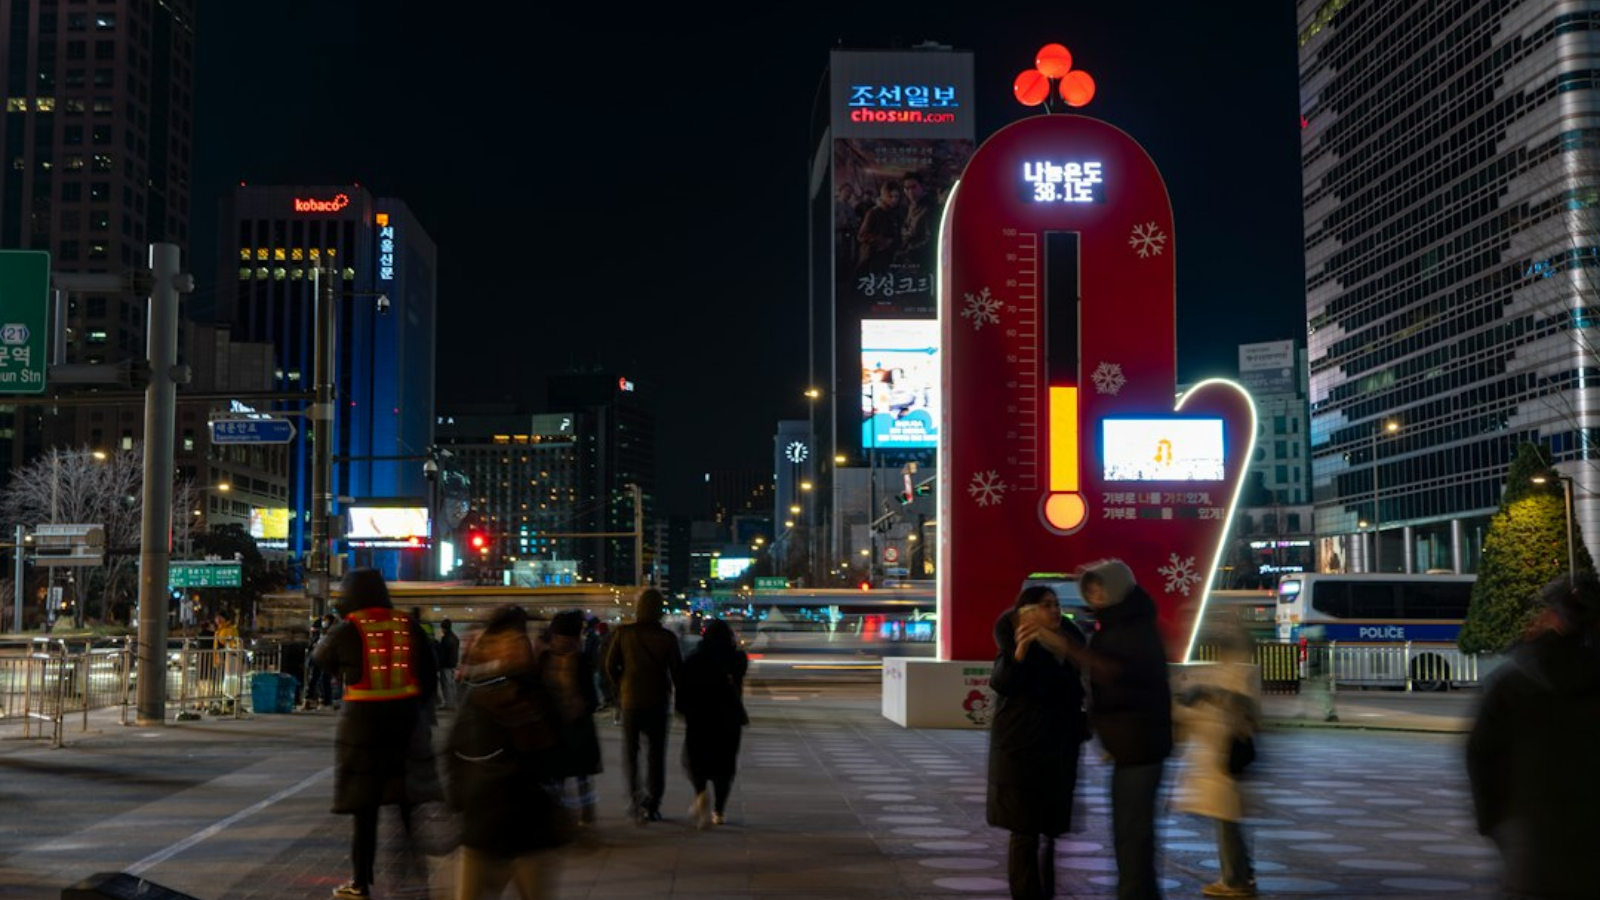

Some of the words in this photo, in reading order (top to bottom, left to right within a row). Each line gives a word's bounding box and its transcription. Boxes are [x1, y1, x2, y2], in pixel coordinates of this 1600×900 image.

[848, 84, 960, 107] 조선일보
[850, 108, 955, 123] chosun.com
[1034, 182, 1094, 202] 38.1도
[294, 197, 340, 212] kobaco
[379, 226, 395, 280] 서울신문
[7, 327, 23, 341] 21
[20, 368, 41, 383] Stn
[1102, 492, 1137, 504] 기부로
[1102, 507, 1138, 520] 기부로
[1359, 626, 1405, 639] POLICE
